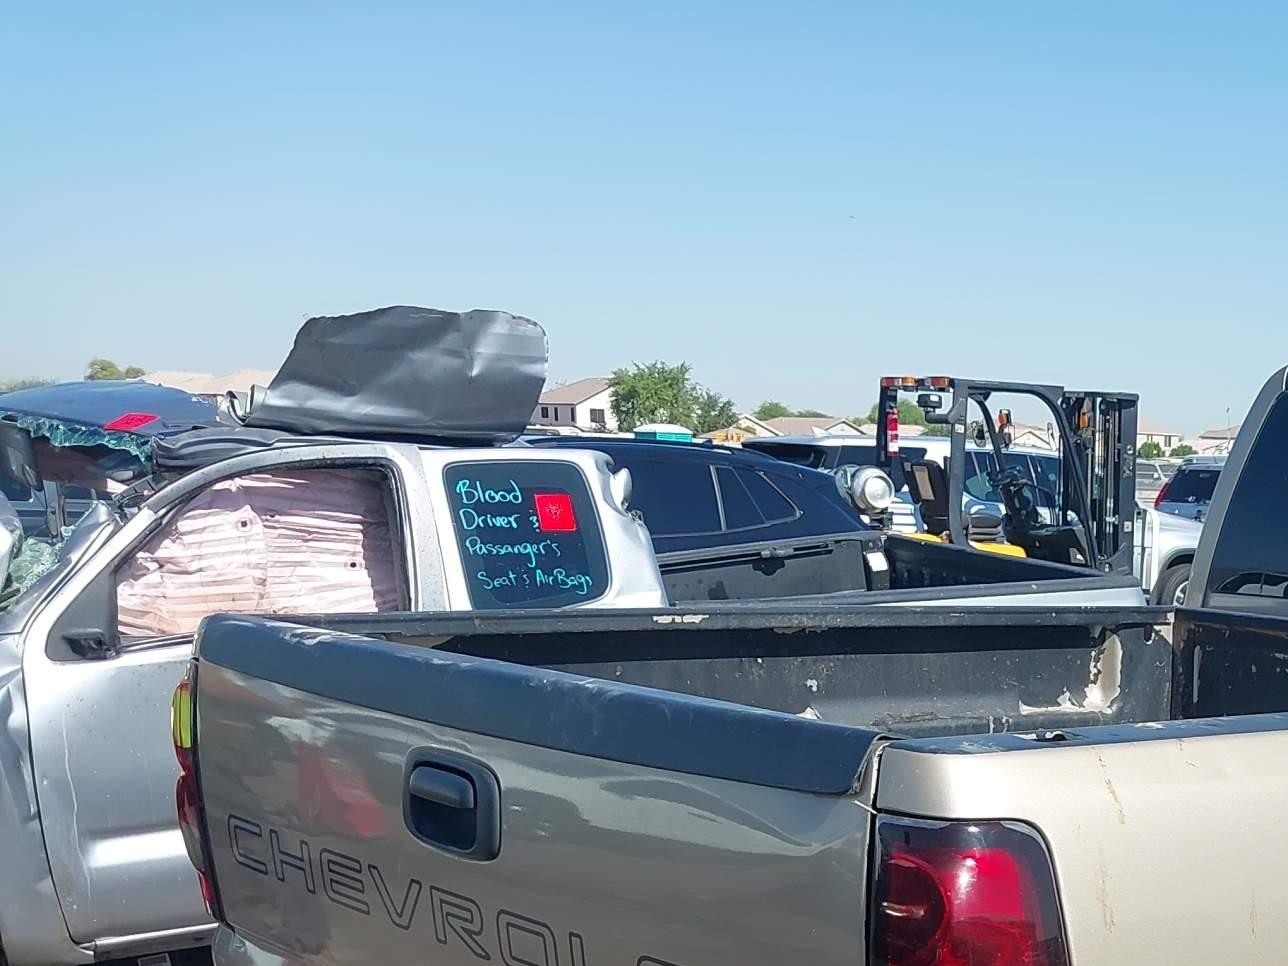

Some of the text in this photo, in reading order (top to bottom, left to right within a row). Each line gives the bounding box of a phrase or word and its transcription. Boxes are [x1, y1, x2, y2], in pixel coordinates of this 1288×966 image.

[456, 480, 522, 504] Blood
[459, 509, 520, 530] Driver
[465, 536, 561, 567] Passanger's
